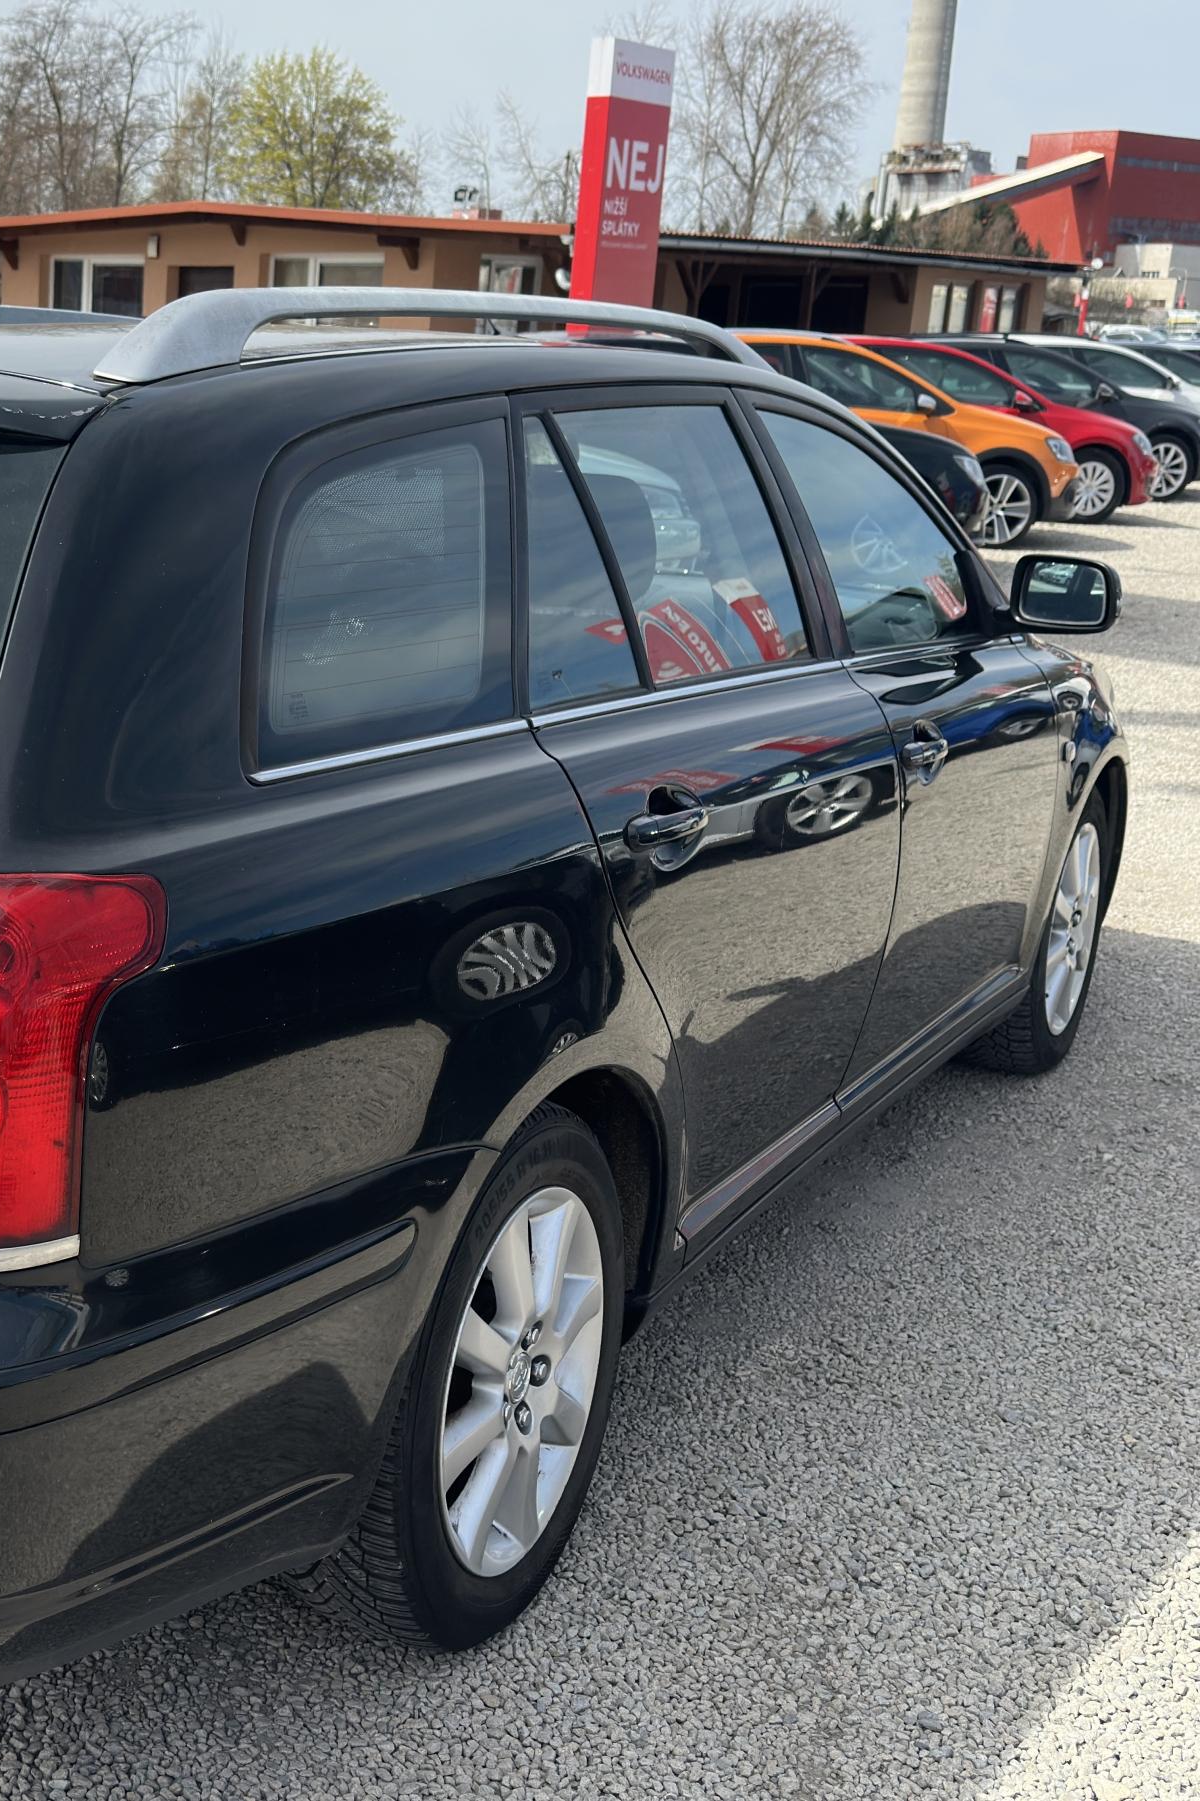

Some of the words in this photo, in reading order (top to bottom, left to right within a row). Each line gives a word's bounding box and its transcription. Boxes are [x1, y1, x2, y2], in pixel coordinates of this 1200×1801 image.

[616, 62, 672, 85] VOLKSWAGEN
[605, 136, 664, 194] NEJ
[601, 218, 640, 238] SPLÁTKY
